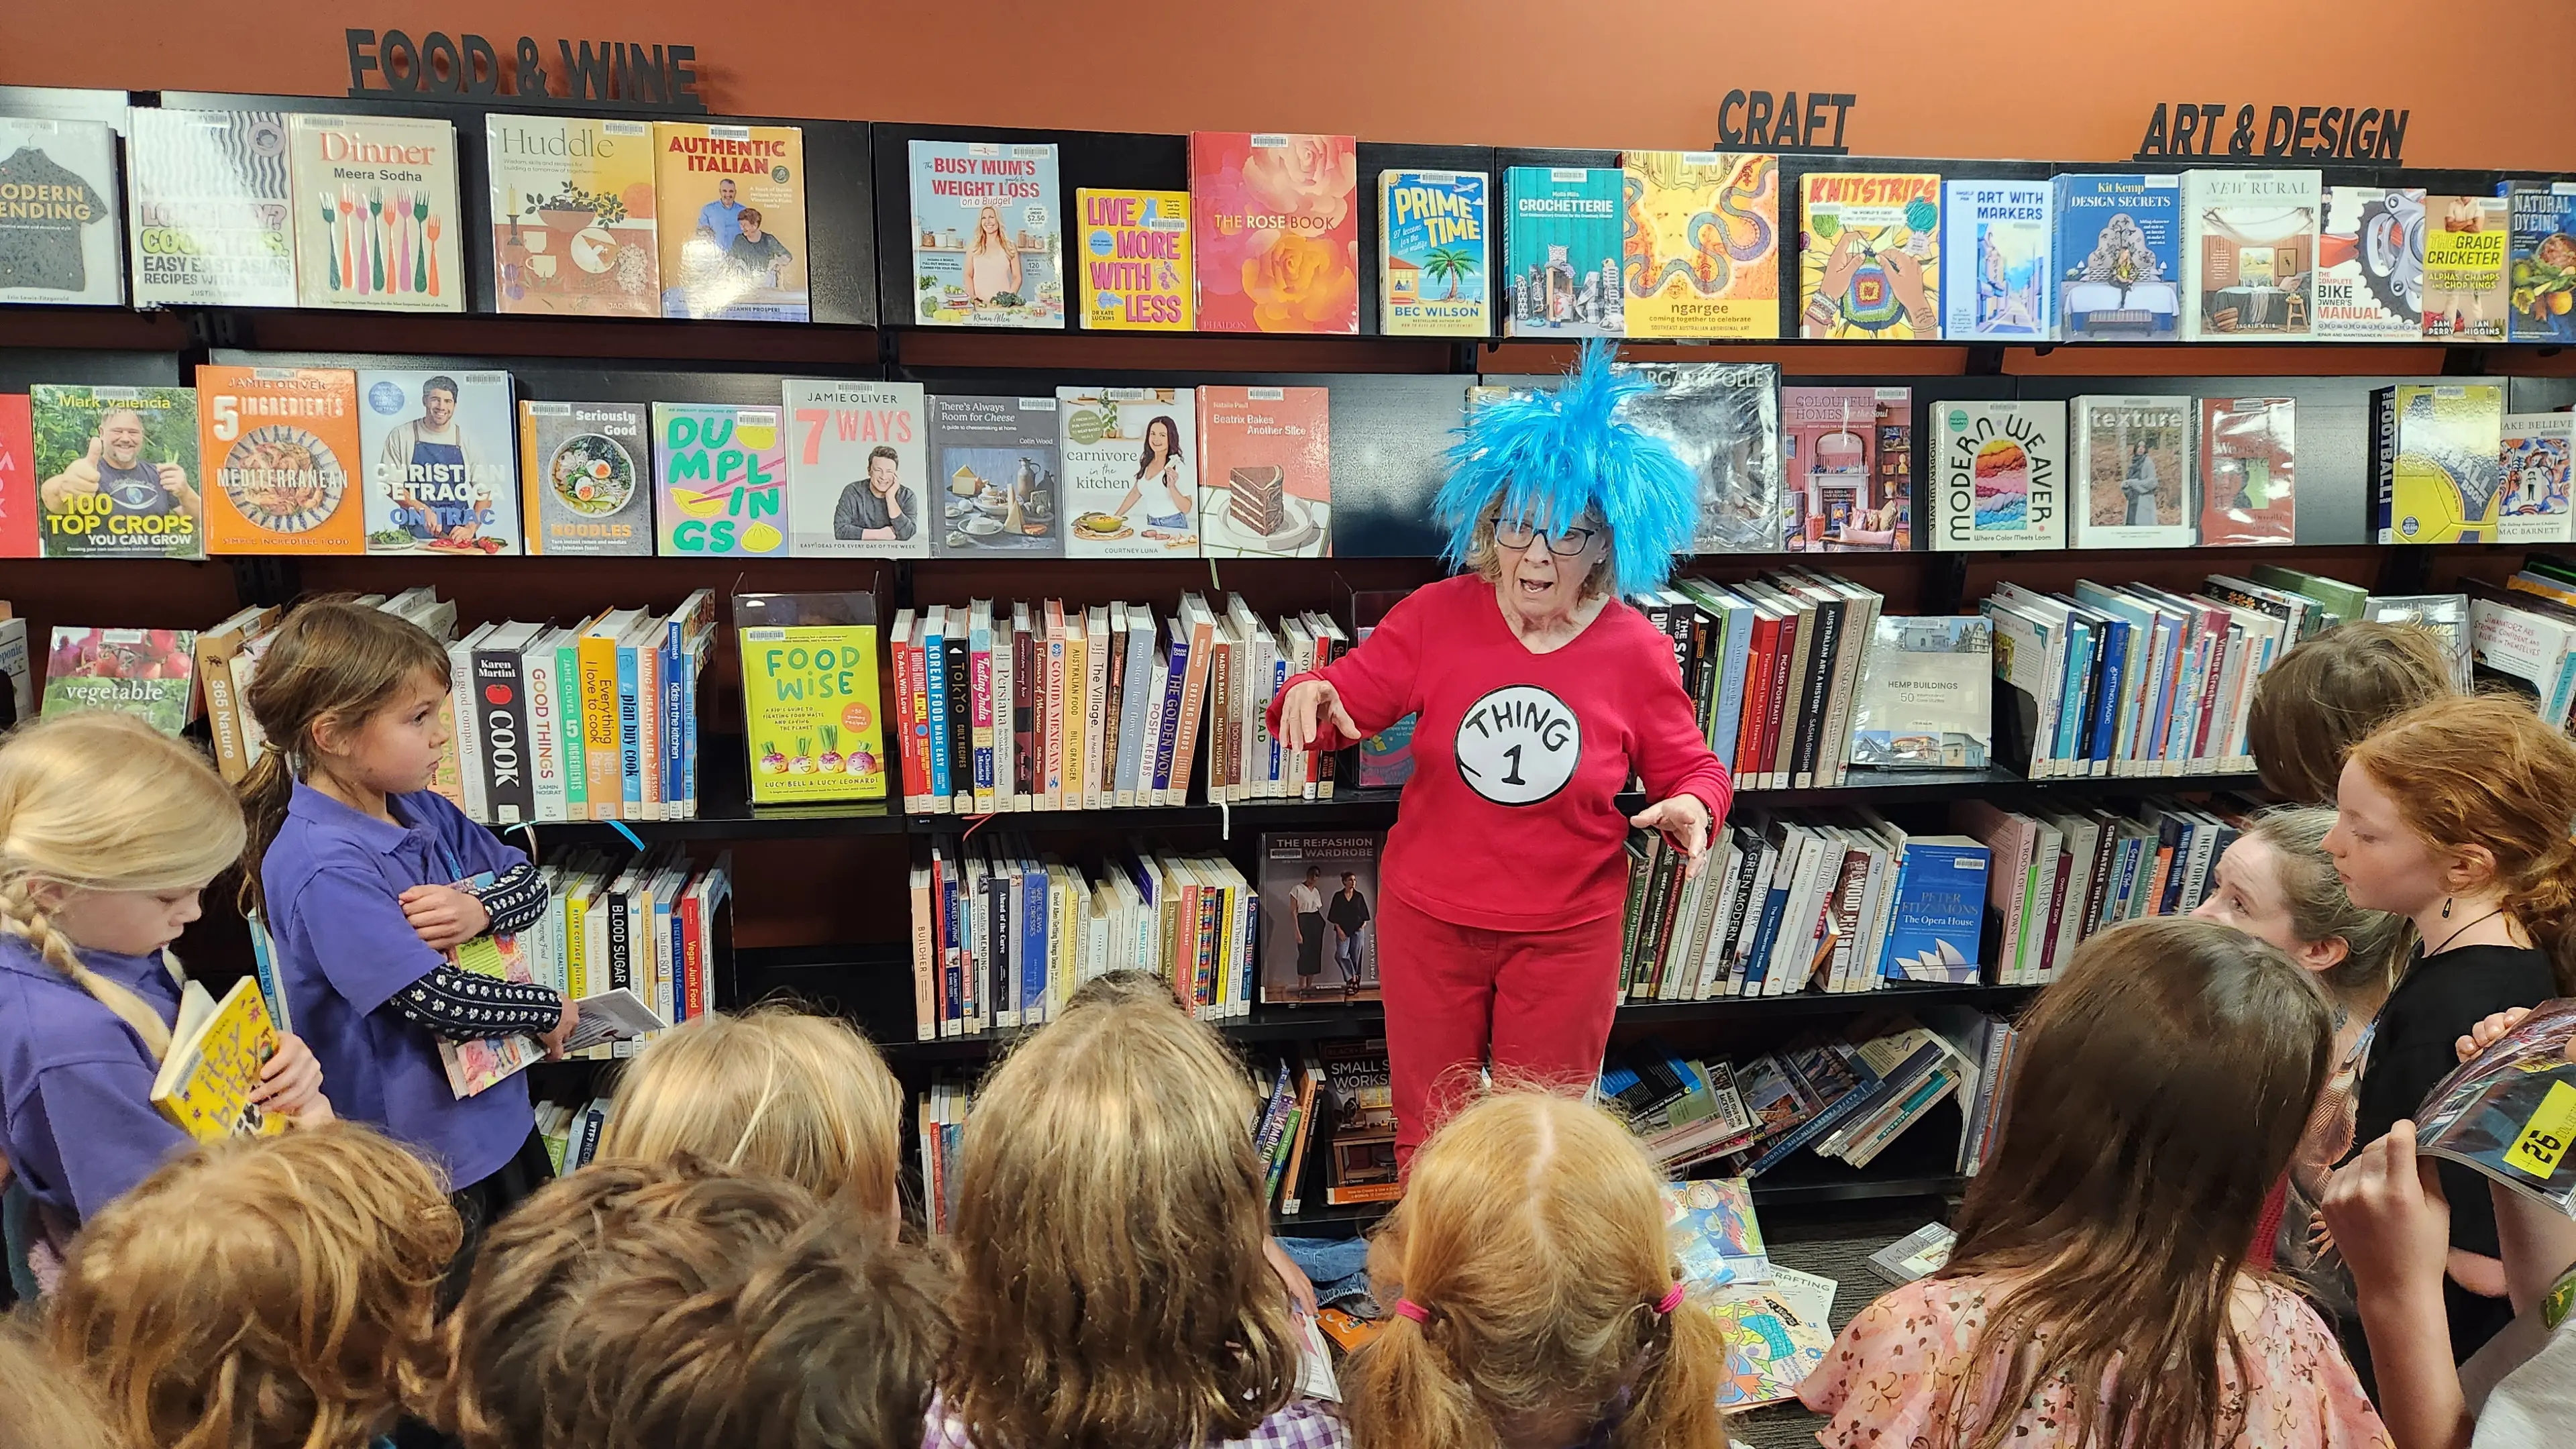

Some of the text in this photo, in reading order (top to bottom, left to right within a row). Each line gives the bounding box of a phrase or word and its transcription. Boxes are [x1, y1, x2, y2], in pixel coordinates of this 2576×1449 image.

[346, 28, 698, 104] FOOD & WINE
[1718, 89, 1856, 148] CRAFT
[2141, 103, 2410, 160] ART & DESIGN
[319, 131, 436, 165] Dinner
[502, 128, 614, 158] Huddle
[669, 136, 786, 158] AUTHENTIC
[688, 156, 768, 174] ITALIAN
[934, 158, 1036, 176] BUSY MUM'S
[335, 168, 422, 182] Meera Sodha
[932, 180, 1040, 198] WEIGHT LOSS
[1808, 178, 1938, 204] KNITSTRIPS
[2251, 182, 2310, 195] RURAL
[983, 197, 1011, 207] Budget
[1394, 186, 1474, 225] PRIME
[1519, 199, 1613, 213] CROCHETTERIE
[1977, 191, 2044, 205] ART WITH
[2071, 196, 2171, 207] DESIGN SECRETS
[2514, 195, 2571, 214] NATURAL
[1087, 197, 1136, 226] LIVE
[1977, 207, 2043, 220] MARKERS
[1214, 215, 1336, 229] THE ROSE BOOK
[2514, 213, 2559, 232] DYEING
[1424, 215, 1481, 248] TIME
[1116, 230, 1181, 260] MORE
[2456, 235, 2503, 249] GRADE
[144, 256, 188, 272] EASY
[2427, 251, 2500, 265] CRICKETER
[144, 273, 198, 284] RECIPES
[1089, 261, 1150, 290] WITH
[2318, 285, 2353, 299] BIKE
[2444, 281, 2469, 289] CHOP
[1126, 294, 1181, 323] LESS
[1395, 307, 1479, 317] BEC WILSON
[1671, 304, 1729, 316] ngargee
[2318, 307, 2382, 320] MANUAL
[1203, 321, 1246, 329] PHAIDON
[2428, 327, 2454, 335] PERRY
[2433, 320, 2450, 328] SAM
[2465, 327, 2500, 335] HIGGINS
[807, 392, 898, 405] JAMIE OLIVER
[1796, 396, 1874, 407] COLOURFUL
[940, 401, 1005, 414] There's Always
[1796, 409, 1888, 419] HOMES Soul
[213, 396, 239, 441] 5
[241, 396, 344, 418] INGREDIENTS
[576, 410, 637, 423] Seriously
[942, 412, 1016, 423] Room for Cheese
[1213, 414, 1274, 425] Beatrix Bakes
[2090, 408, 2183, 428] texture
[2528, 420, 2573, 429] BELIEVE
[604, 424, 637, 436] Good
[796, 409, 912, 465] 7 WAYS
[1247, 425, 1306, 435] Another Slice
[1067, 449, 1138, 462] carnivore
[1089, 463, 1117, 475] in the
[216, 468, 349, 489] MEDITERRANEAN
[1076, 476, 1131, 490] kitchen
[62, 493, 113, 515] 100
[46, 515, 194, 535] TOP CROPS
[551, 523, 632, 538] NOODLES
[88, 534, 192, 545] YOU CAN GROW
[2499, 629, 2528, 643] CONFIDENT
[2504, 640, 2540, 656] THEMSELVES
[480, 659, 511, 669] Karen
[766, 646, 860, 677] FOOD
[928, 645, 943, 690] KOREAN
[1218, 653, 1226, 680] NADIYA
[478, 667, 517, 678] Martini
[1072, 649, 1080, 691] AUSTRALIAN
[1051, 661, 1061, 707] COMIDA
[1888, 681, 1958, 690] HEMP BUILDINGS
[66, 680, 164, 706] vegetable
[1232, 671, 1241, 718] HOLLYWOOD
[1900, 692, 1915, 703] 50
[211, 680, 234, 759] 365 Nature
[600, 680, 614, 744] Everything
[532, 668, 554, 779] GOOD THINGS
[1258, 698, 1268, 744] SALAD
[1464, 700, 1571, 752] THING
[488, 709, 520, 788] COOK
[1069, 749, 1077, 782] GRANGER
[1501, 743, 1526, 786] 1
[1277, 839, 1373, 847] THE RE:FASHION
[1305, 849, 1373, 857] WARDROBE
[2190, 833, 2213, 890] NEW YORK
[1727, 853, 1758, 942] GREEN MODERN
[1903, 914, 1974, 926] The Opera House
[612, 905, 627, 983] BLOOD SUGAR
[686, 940, 698, 1009] Vegan Junk Food
[1331, 1062, 1379, 1075] SMALL
[2522, 1130, 2562, 1163] 26
